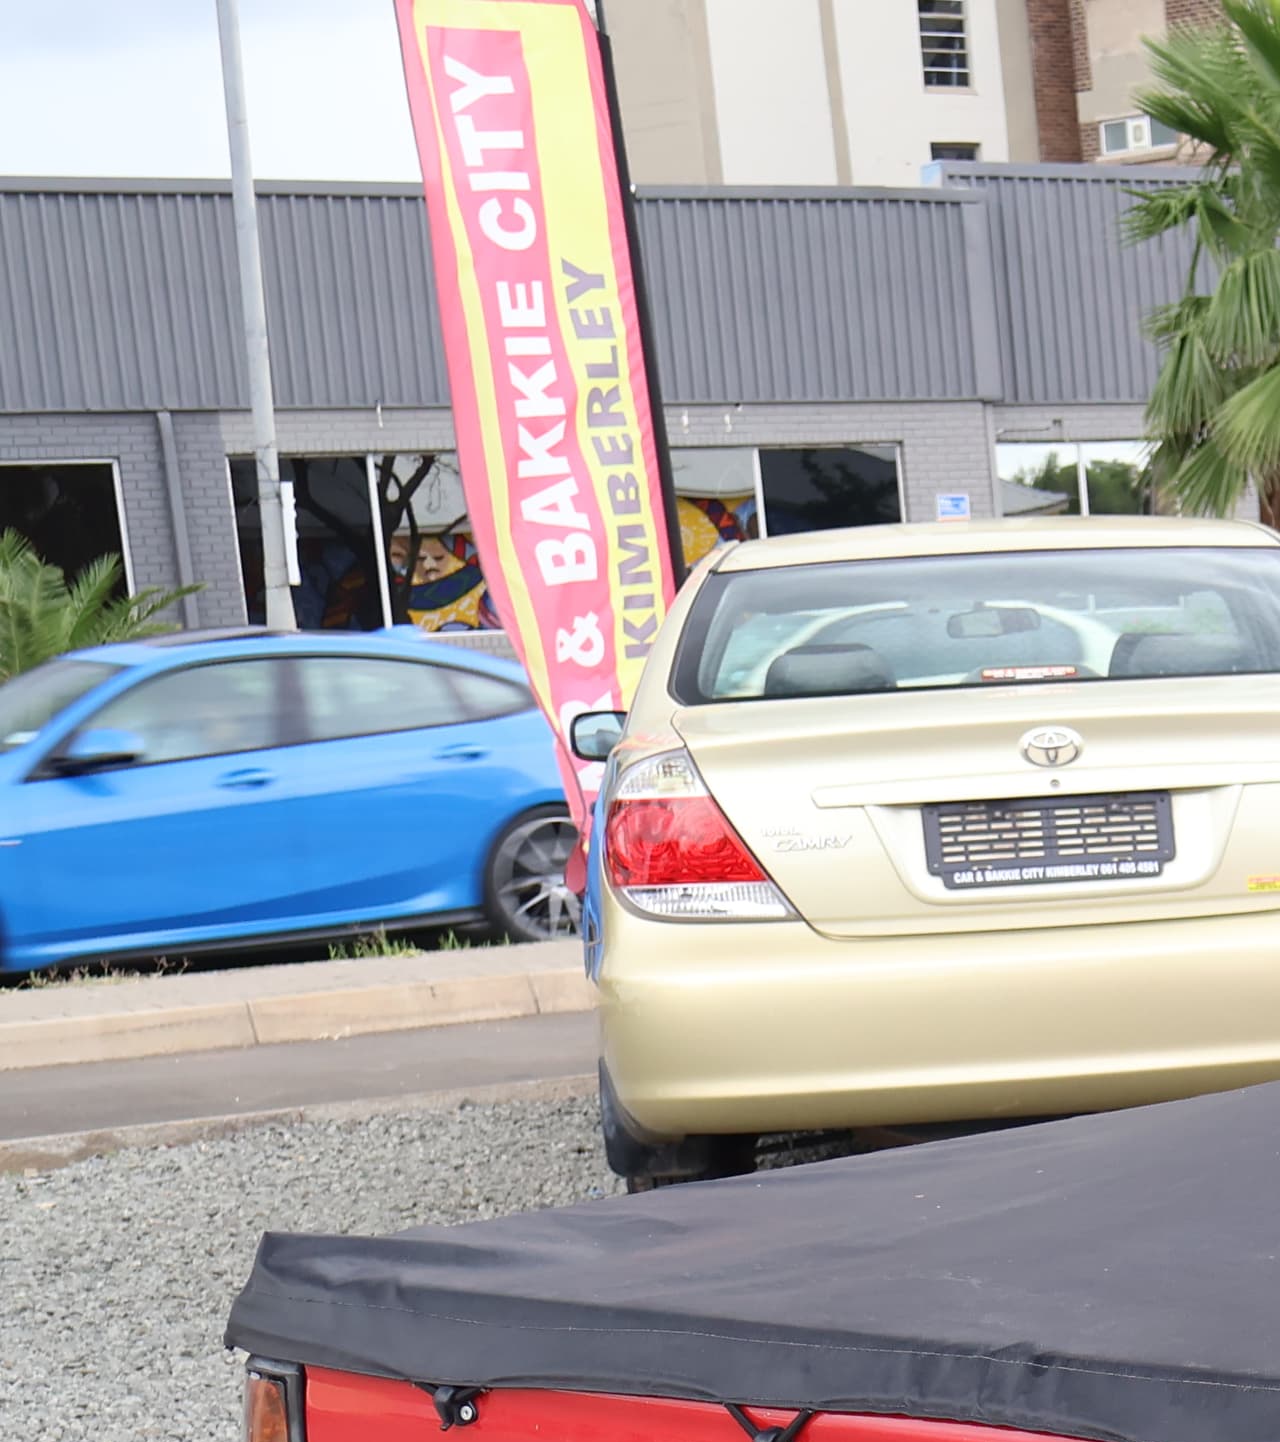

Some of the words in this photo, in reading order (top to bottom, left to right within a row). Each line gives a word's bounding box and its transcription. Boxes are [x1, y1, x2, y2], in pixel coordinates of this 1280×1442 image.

[443, 54, 539, 252] CITY
[495, 280, 599, 587] BAKKIE
[560, 258, 658, 659] KIMBERLEY
[555, 611, 605, 667] &
[953, 870, 975, 884] CAR
[1021, 866, 1044, 880] CITY
[1045, 863, 1099, 878] KIMBERLEY
